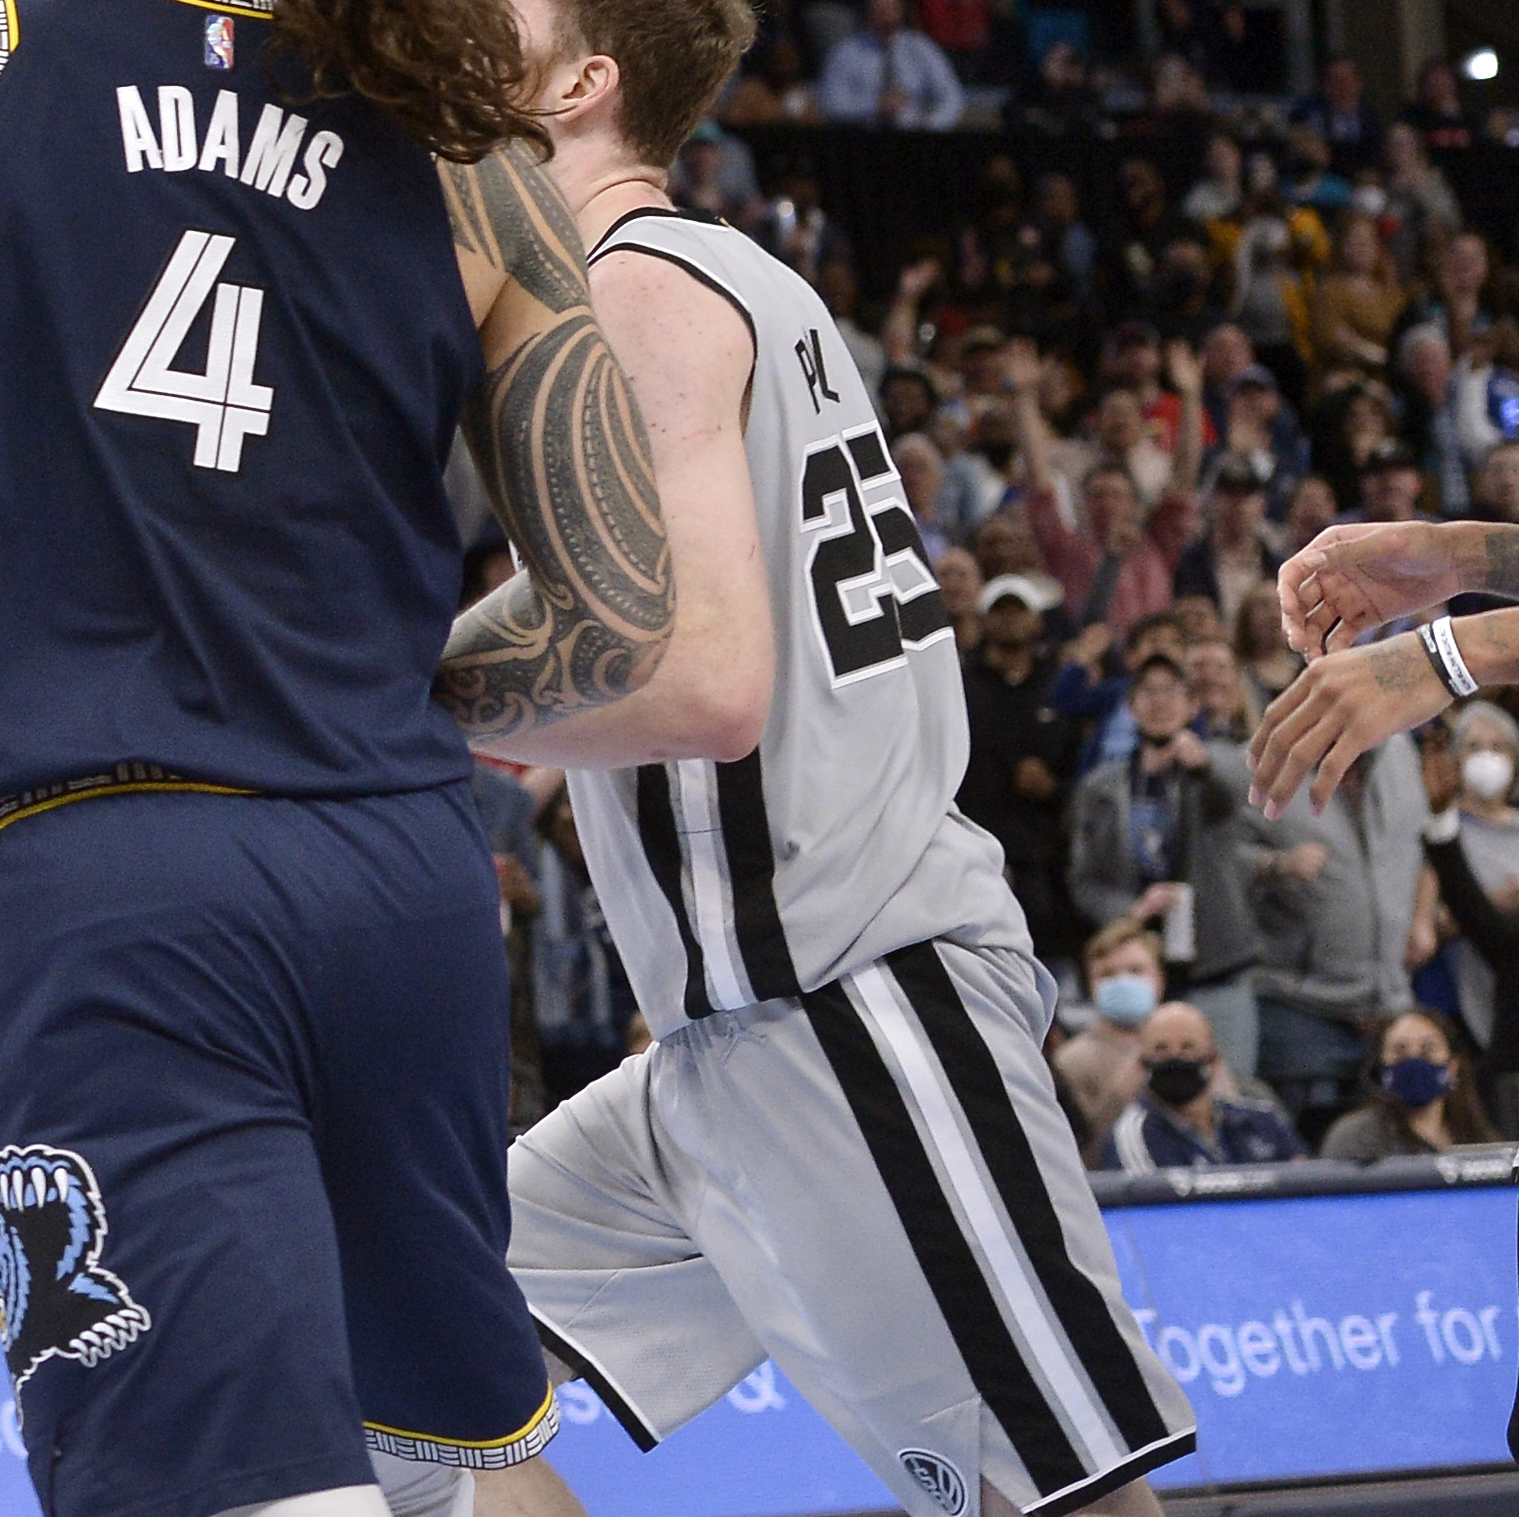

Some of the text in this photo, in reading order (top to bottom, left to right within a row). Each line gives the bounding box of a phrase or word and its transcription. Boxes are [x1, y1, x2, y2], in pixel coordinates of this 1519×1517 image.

[115, 84, 345, 211] ADAMS
[92, 229, 275, 474] 4
[799, 419, 956, 690] 25
[1415, 1290, 1504, 1365] for
